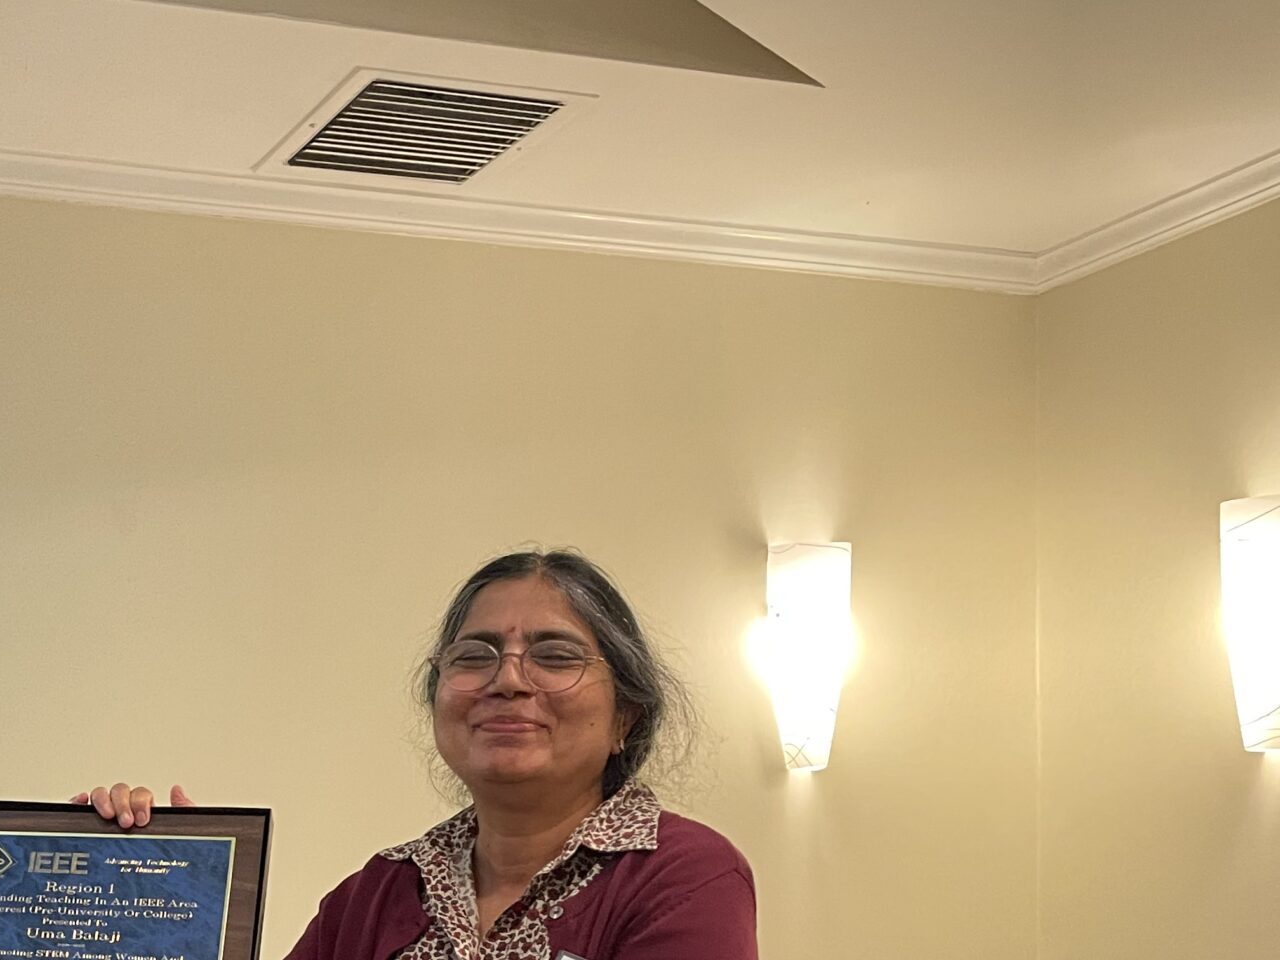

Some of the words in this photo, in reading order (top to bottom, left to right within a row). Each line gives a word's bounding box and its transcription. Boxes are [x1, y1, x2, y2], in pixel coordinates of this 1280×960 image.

[27, 851, 90, 875] IEEE
[146, 858, 190, 868] Technology
[135, 866, 170, 875] Humanity
[45, 880, 102, 895] Region
[108, 883, 115, 895] 1
[36, 894, 92, 906] Teaching
[95, 896, 107, 905] In
[111, 897, 129, 906] An
[133, 898, 164, 907] IEEE
[168, 899, 198, 908] Area
[29, 906, 121, 918] (Pre-University
[124, 909, 139, 918] Or
[143, 910, 193, 921] College)
[42, 917, 91, 926] Presented
[94, 919, 108, 927] To
[26, 927, 66, 940] Uma
[72, 927, 121, 944] Balaji
[35, 949, 69, 958] STEM
